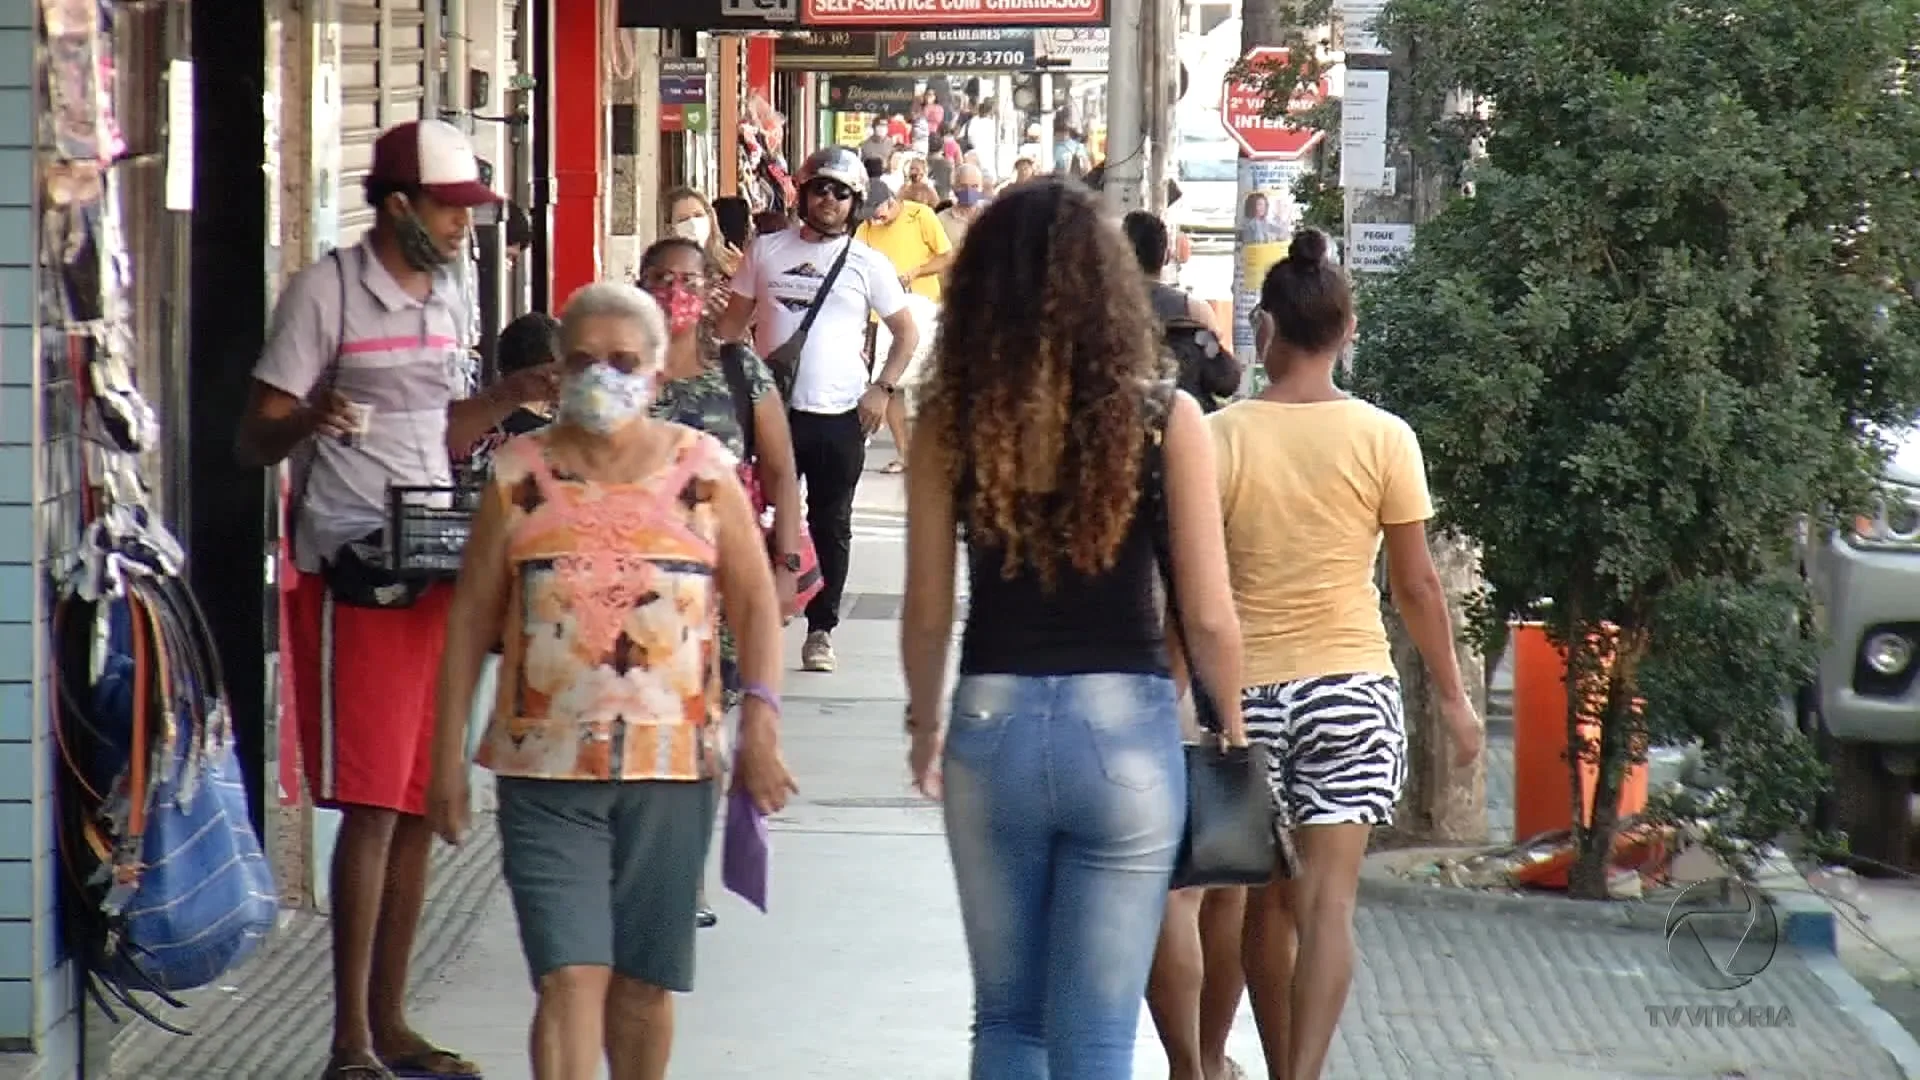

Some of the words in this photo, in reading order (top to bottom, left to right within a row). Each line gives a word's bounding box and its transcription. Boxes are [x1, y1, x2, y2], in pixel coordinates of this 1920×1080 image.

[815, 0, 936, 12] SELF-SERVICE
[941, 0, 981, 10] COM
[924, 50, 1025, 67] 99773-3700
[1363, 231, 1394, 240] PEGUE
